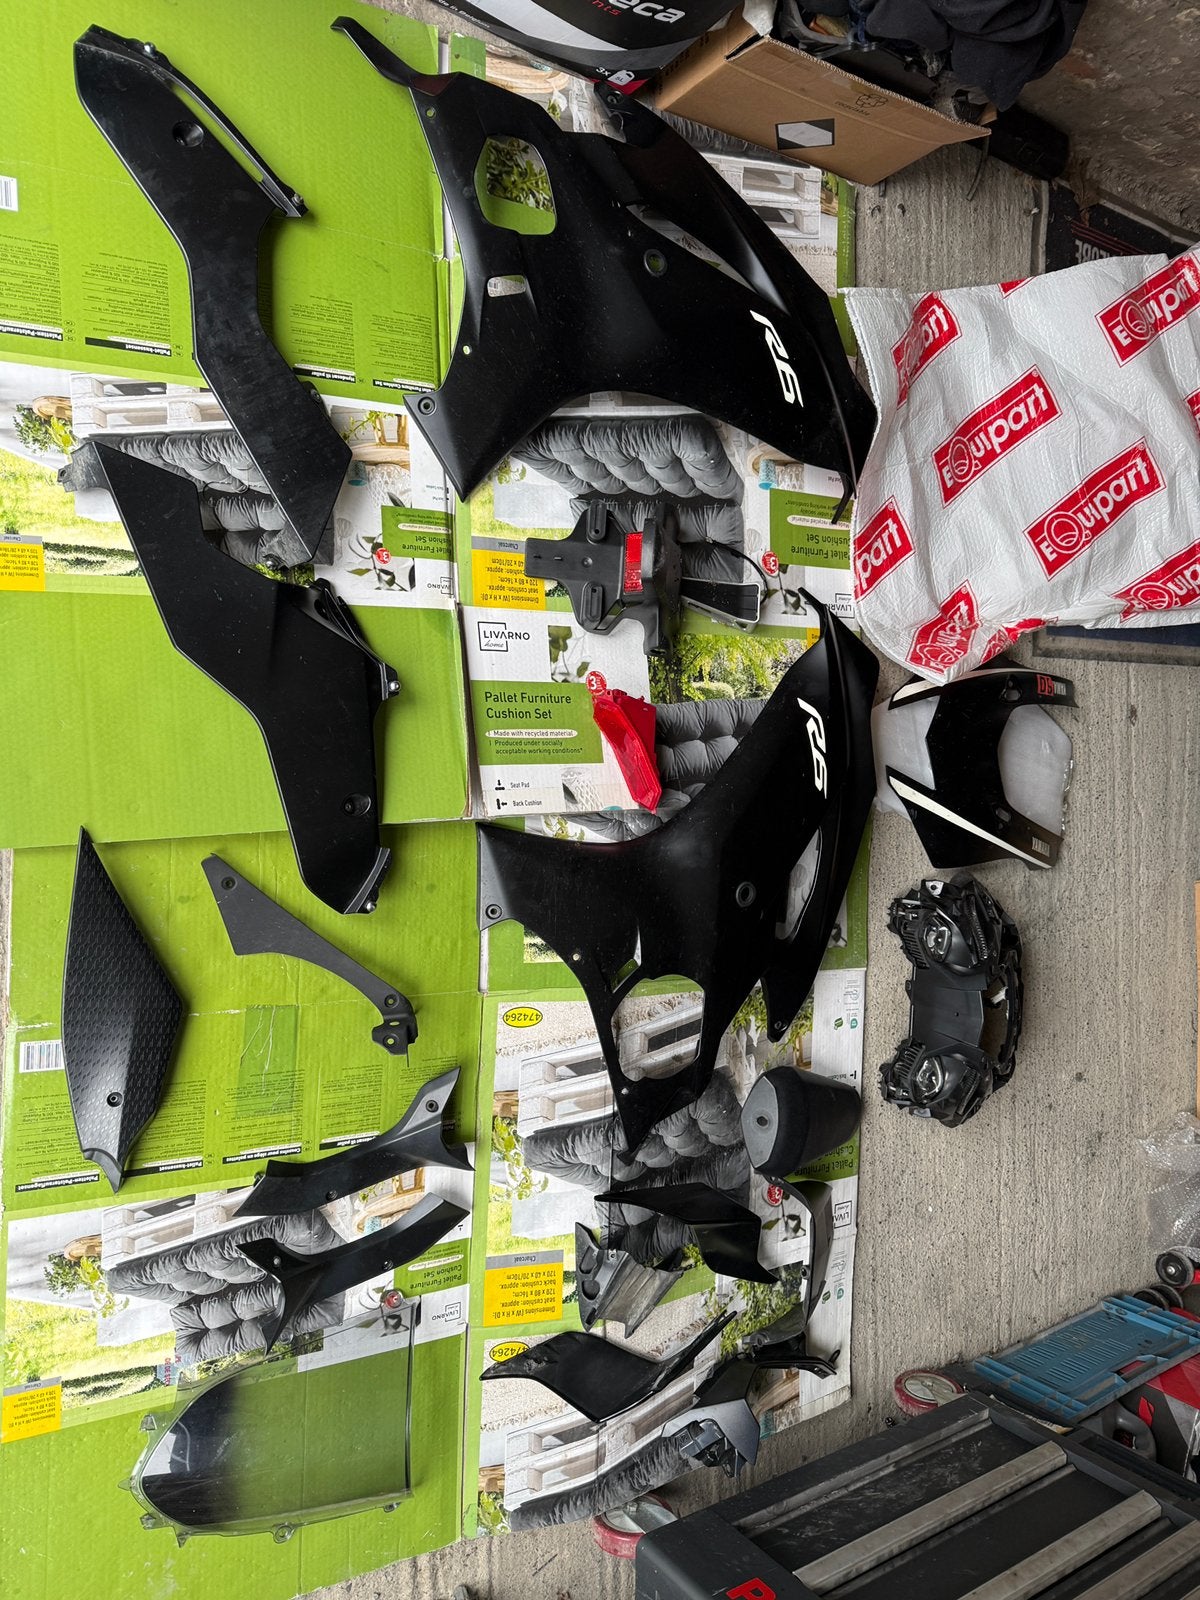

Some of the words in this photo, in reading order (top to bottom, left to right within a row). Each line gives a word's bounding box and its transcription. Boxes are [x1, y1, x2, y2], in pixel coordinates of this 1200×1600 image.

[749, 309, 804, 408] R6
[807, 534, 819, 544] Set
[402, 544, 435, 553] Furniture
[791, 546, 828, 558] Furniture
[831, 550, 850, 560] allet
[483, 630, 530, 640] LIVARNO
[484, 640, 504, 648] home
[590, 676, 596, 690] 3
[485, 692, 518, 703] Pallet
[521, 692, 572, 704] Furniture
[486, 708, 531, 719] Cushion
[534, 709, 552, 719] Set
[797, 697, 828, 799] R6
[506, 1013, 540, 1021] 474264
[832, 1159, 853, 1170] Pallet
[833, 1211, 849, 1222] LIVA
[436, 1264, 462, 1275] Cushion
[409, 1277, 442, 1290] Furniture
[443, 1273, 462, 1284] Pallet
[520, 1280, 542, 1288] cushion:
[431, 1309, 459, 1320] LIVARNO
[525, 1306, 555, 1314] Dimensions
